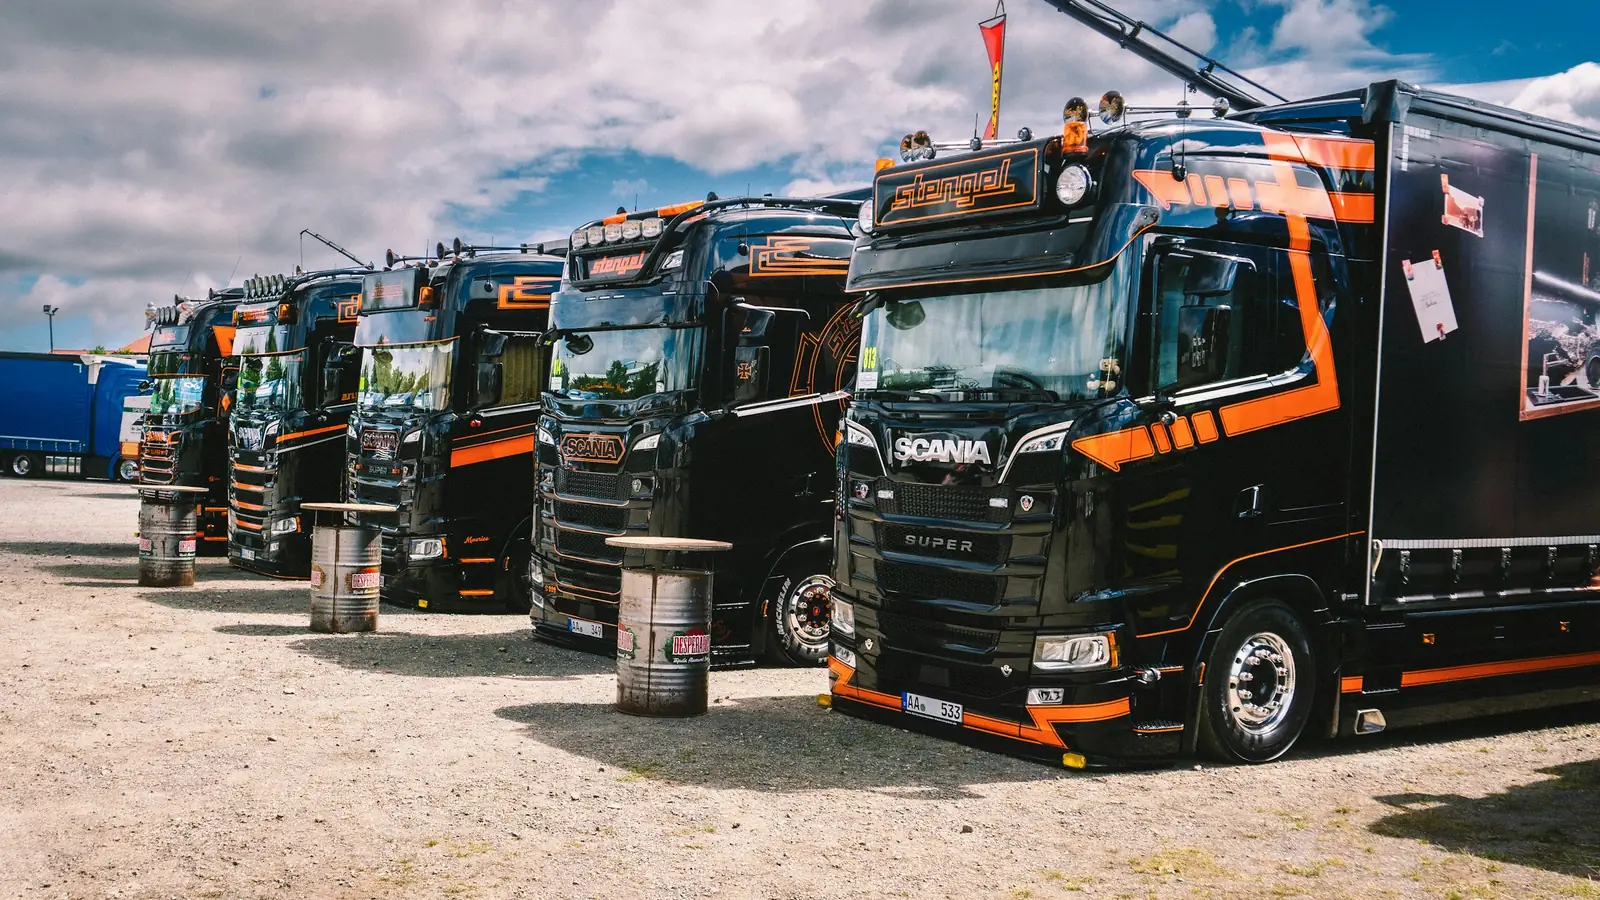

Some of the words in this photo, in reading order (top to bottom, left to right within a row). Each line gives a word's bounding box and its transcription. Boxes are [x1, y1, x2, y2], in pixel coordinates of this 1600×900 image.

[891, 158, 1015, 210] stengel
[590, 250, 645, 275] stengel
[863, 347, 877, 369] 813
[566, 438, 617, 459] SCANIA
[894, 437, 991, 465] SCANIA
[905, 534, 973, 552] SUPER
[908, 695, 920, 711] AA
[941, 702, 961, 720] 533
